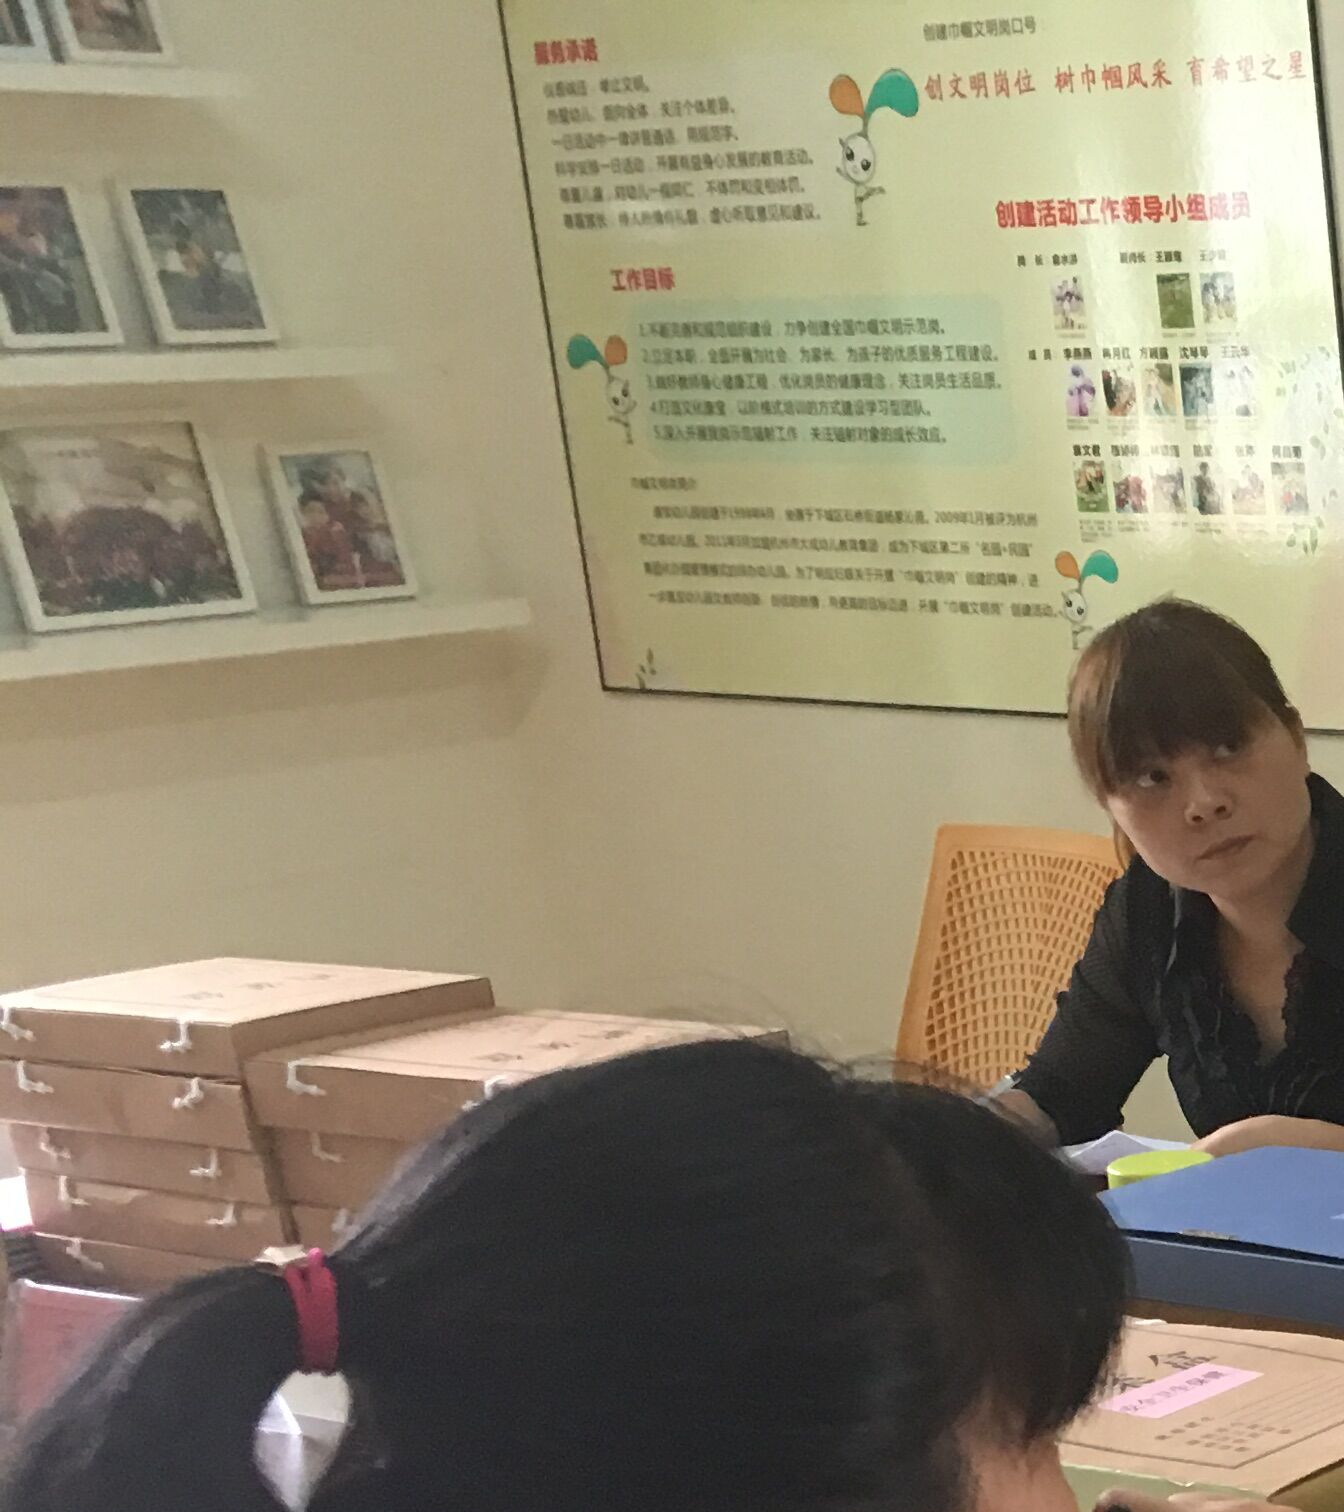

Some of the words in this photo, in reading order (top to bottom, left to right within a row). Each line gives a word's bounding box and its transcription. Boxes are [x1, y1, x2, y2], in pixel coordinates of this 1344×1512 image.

[923, 15, 1036, 41] 创建巾帼文明岗口号
[924, 66, 1036, 101] 创文明岗位
[996, 191, 1251, 229] 创建活动工作领导小组成员
[610, 267, 675, 291] 工作目标
